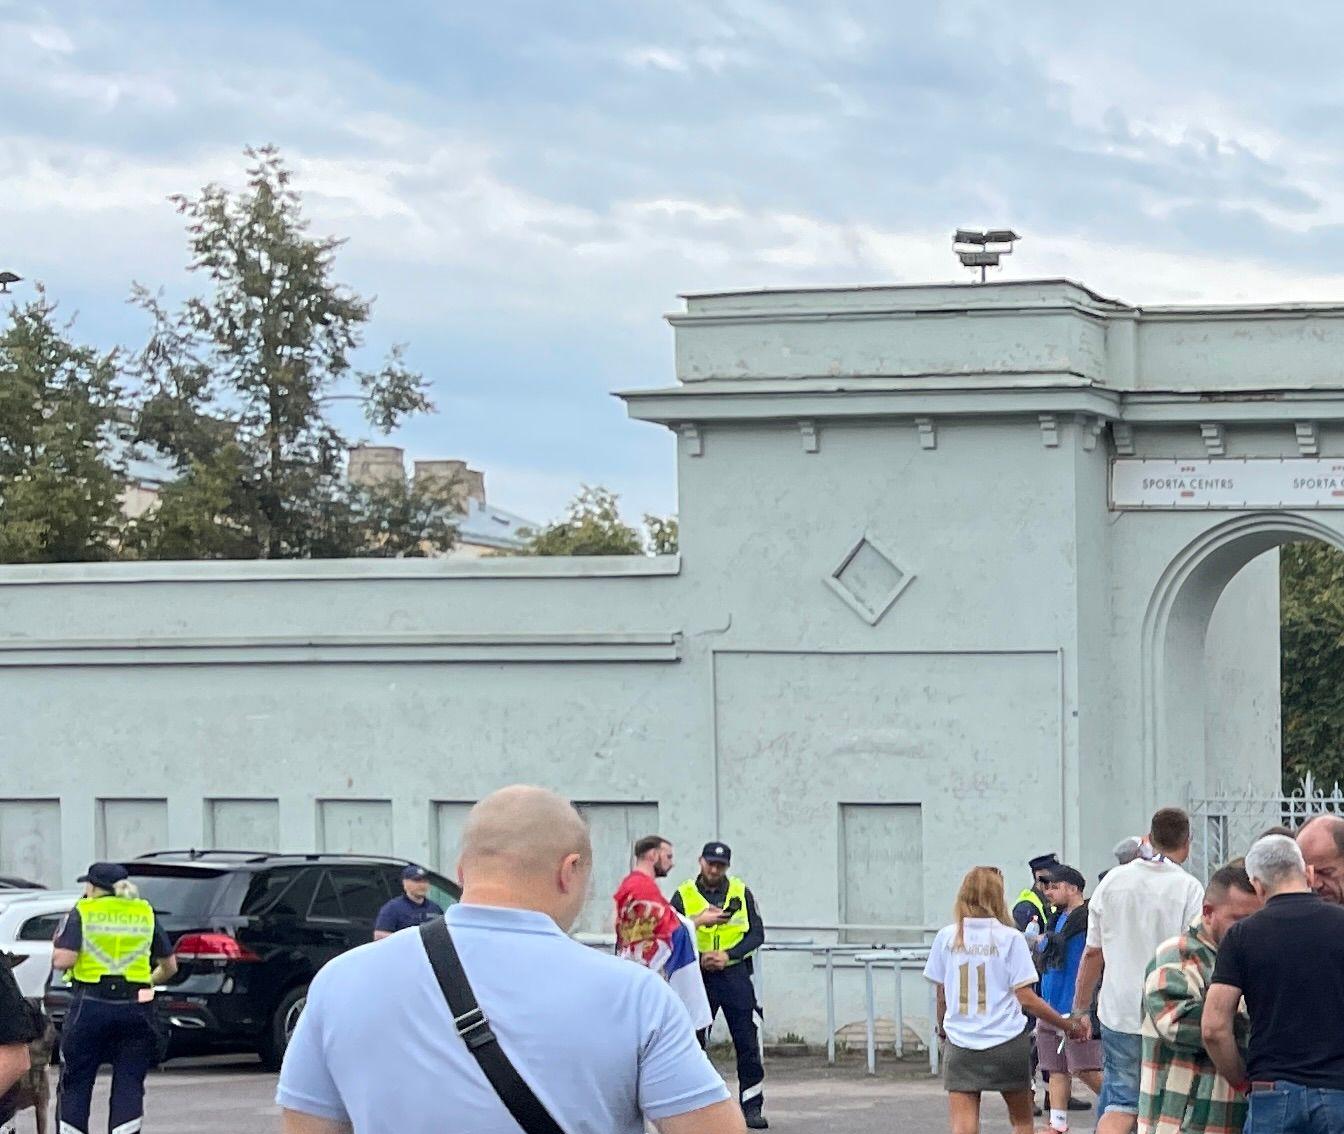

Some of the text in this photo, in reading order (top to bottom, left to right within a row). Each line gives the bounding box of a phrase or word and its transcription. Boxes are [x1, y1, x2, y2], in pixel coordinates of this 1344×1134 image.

[1142, 478, 1234, 490] SPORTA CENTRS
[1293, 478, 1337, 489] SPORTA
[87, 911, 149, 926] POLICIJA
[958, 961, 987, 1017] 11
